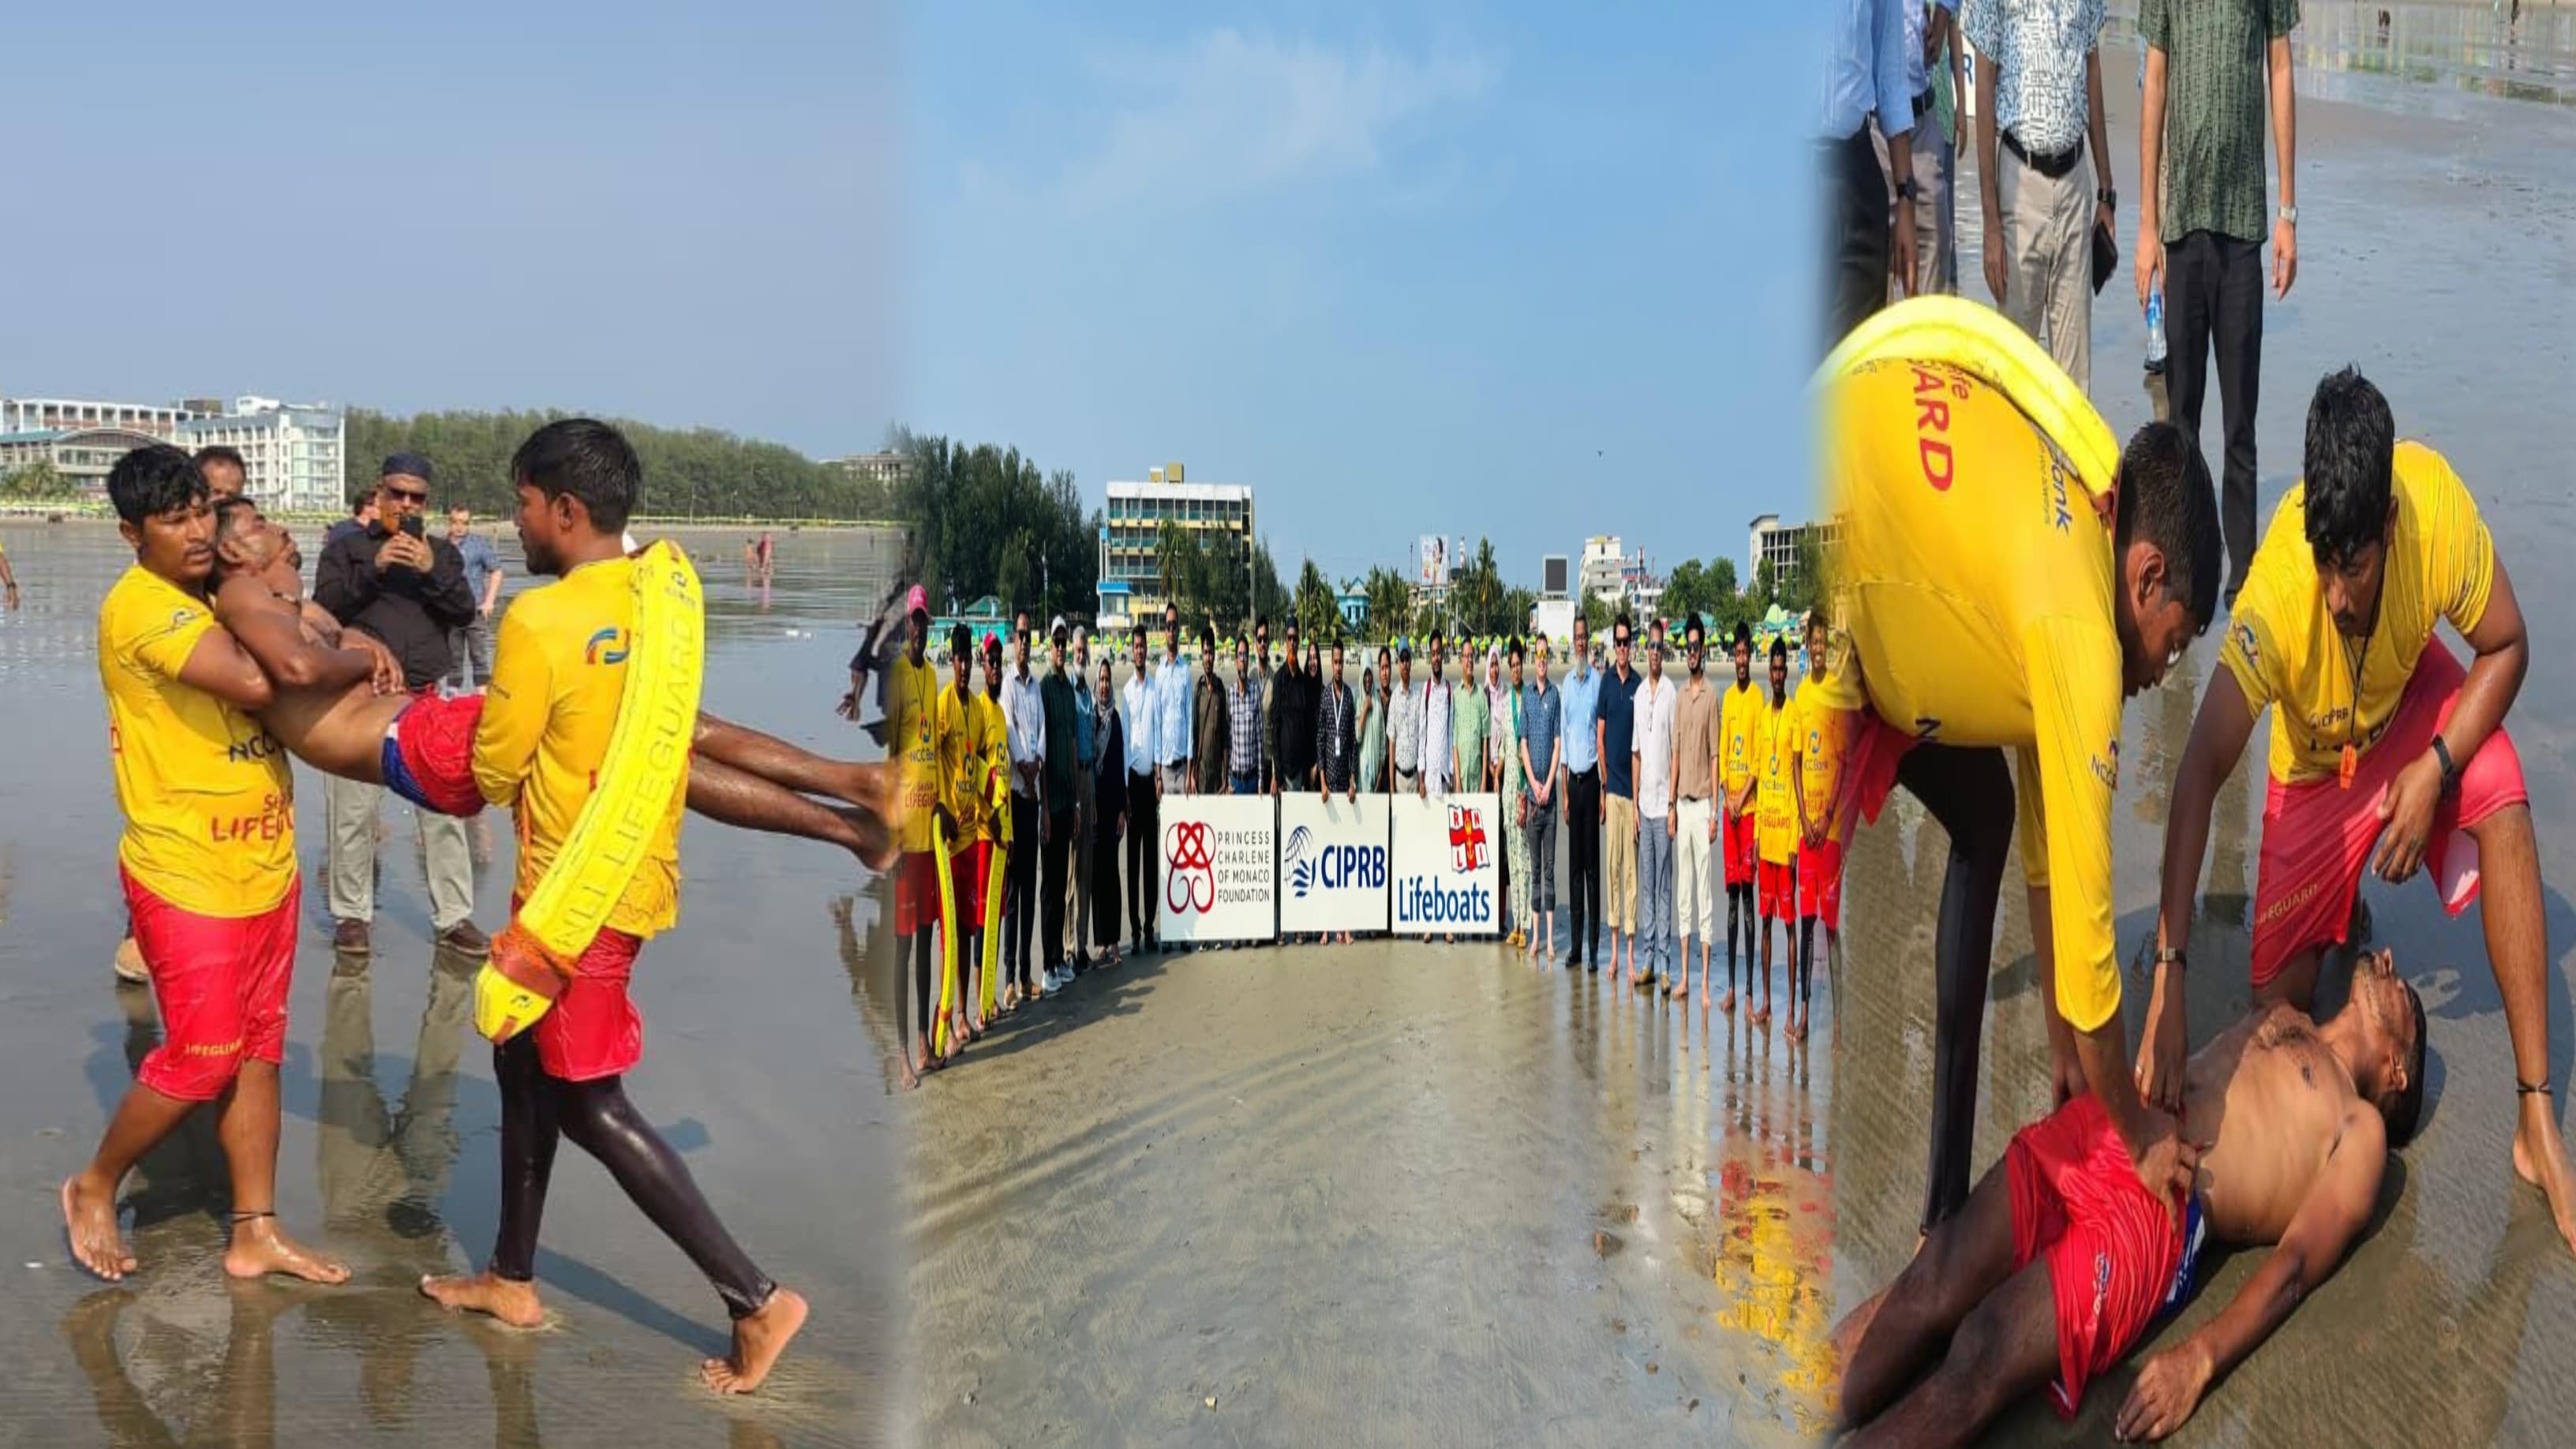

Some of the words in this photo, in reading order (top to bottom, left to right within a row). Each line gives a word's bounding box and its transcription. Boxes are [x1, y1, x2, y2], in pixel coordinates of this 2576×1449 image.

[1906, 358, 1954, 492] ARD
[1218, 830, 1269, 845] PRINCESS
[1218, 850, 1269, 864] CHARLENE
[1321, 844, 1385, 888] CIPRB
[1218, 869, 1229, 883] OF
[1233, 869, 1269, 883] MONACO
[1218, 888, 1269, 903] FOUNDATION
[1399, 874, 1490, 922] Lifeboats
